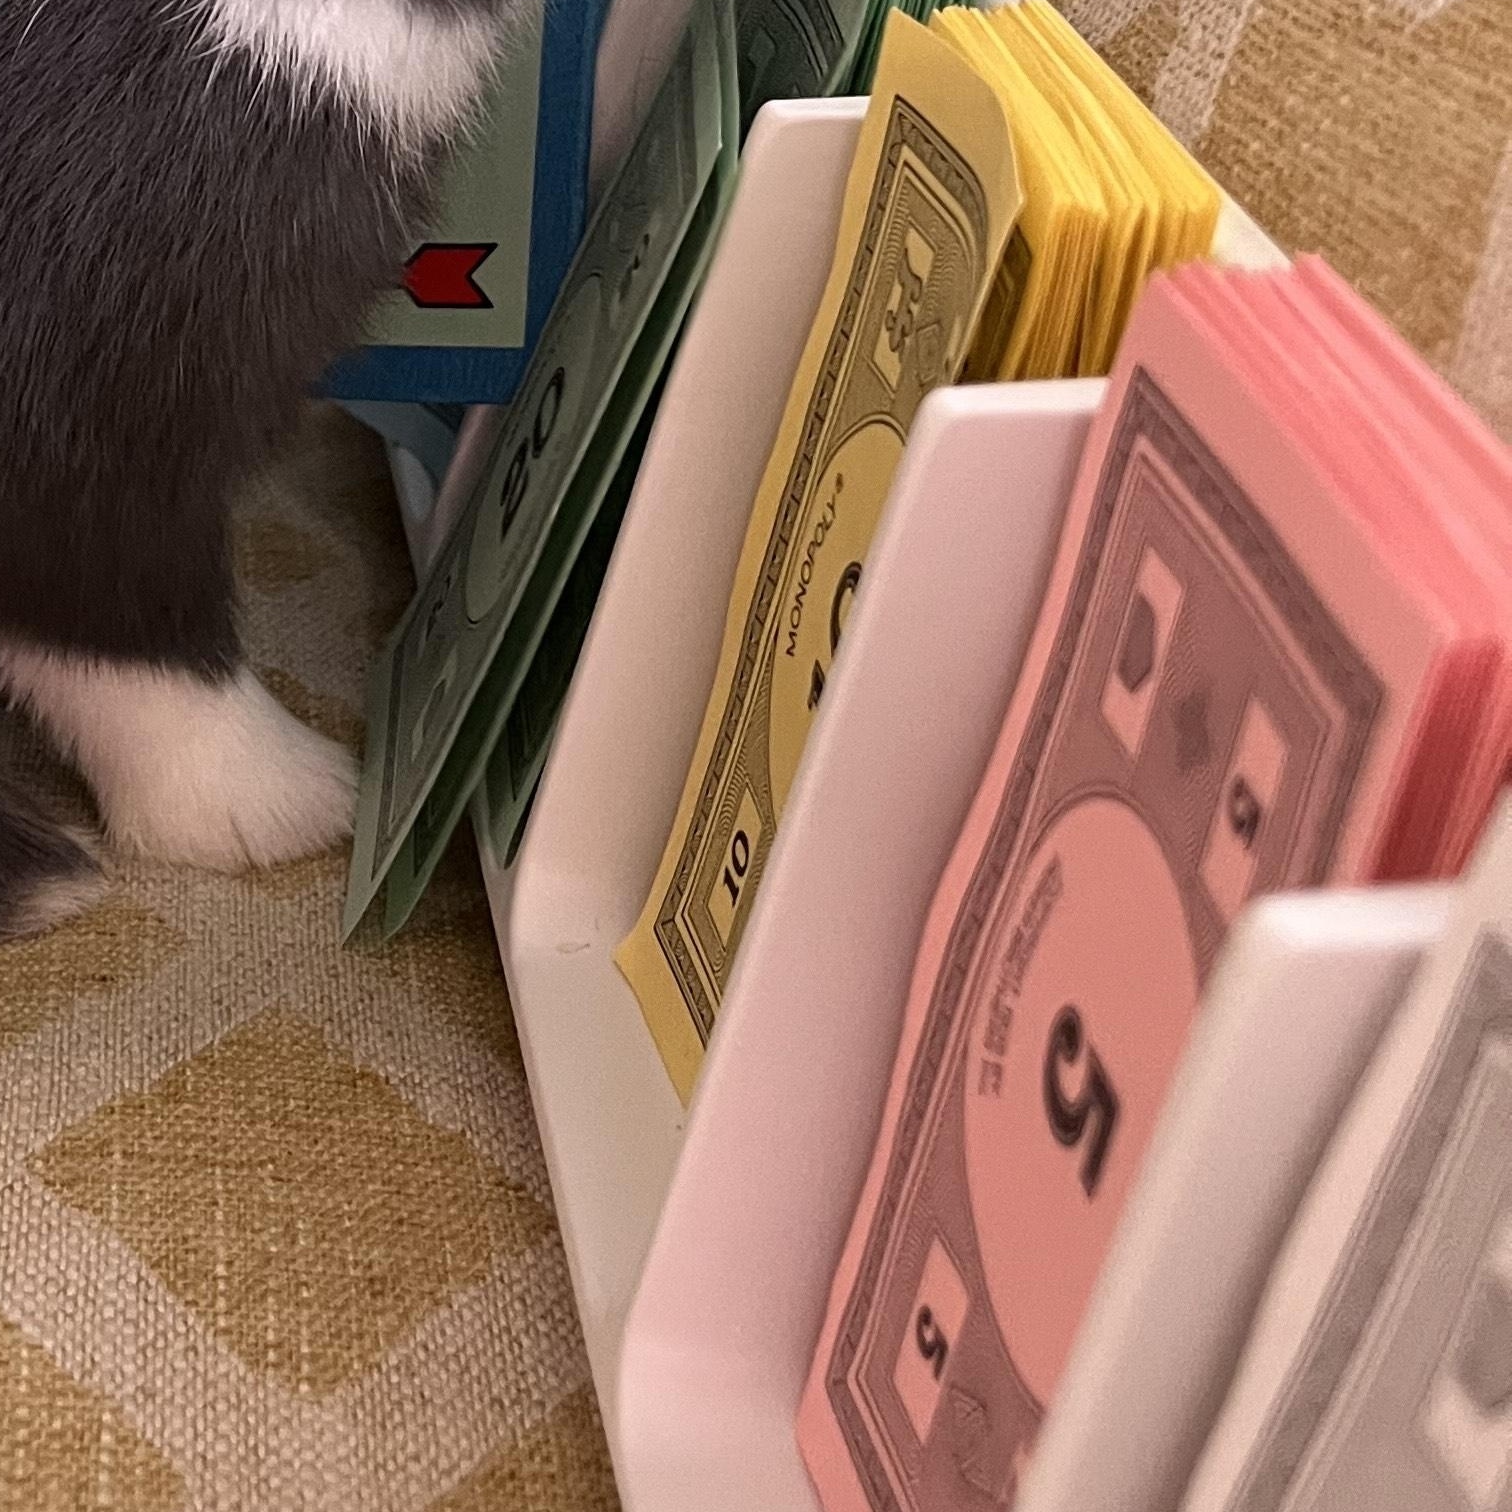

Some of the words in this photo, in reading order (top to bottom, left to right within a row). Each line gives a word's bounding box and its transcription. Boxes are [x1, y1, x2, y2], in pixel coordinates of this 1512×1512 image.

[500, 366, 565, 543] 20
[724, 829, 749, 908] 10
[1043, 1003, 1121, 1204] 5
[916, 1304, 949, 1381] 5
